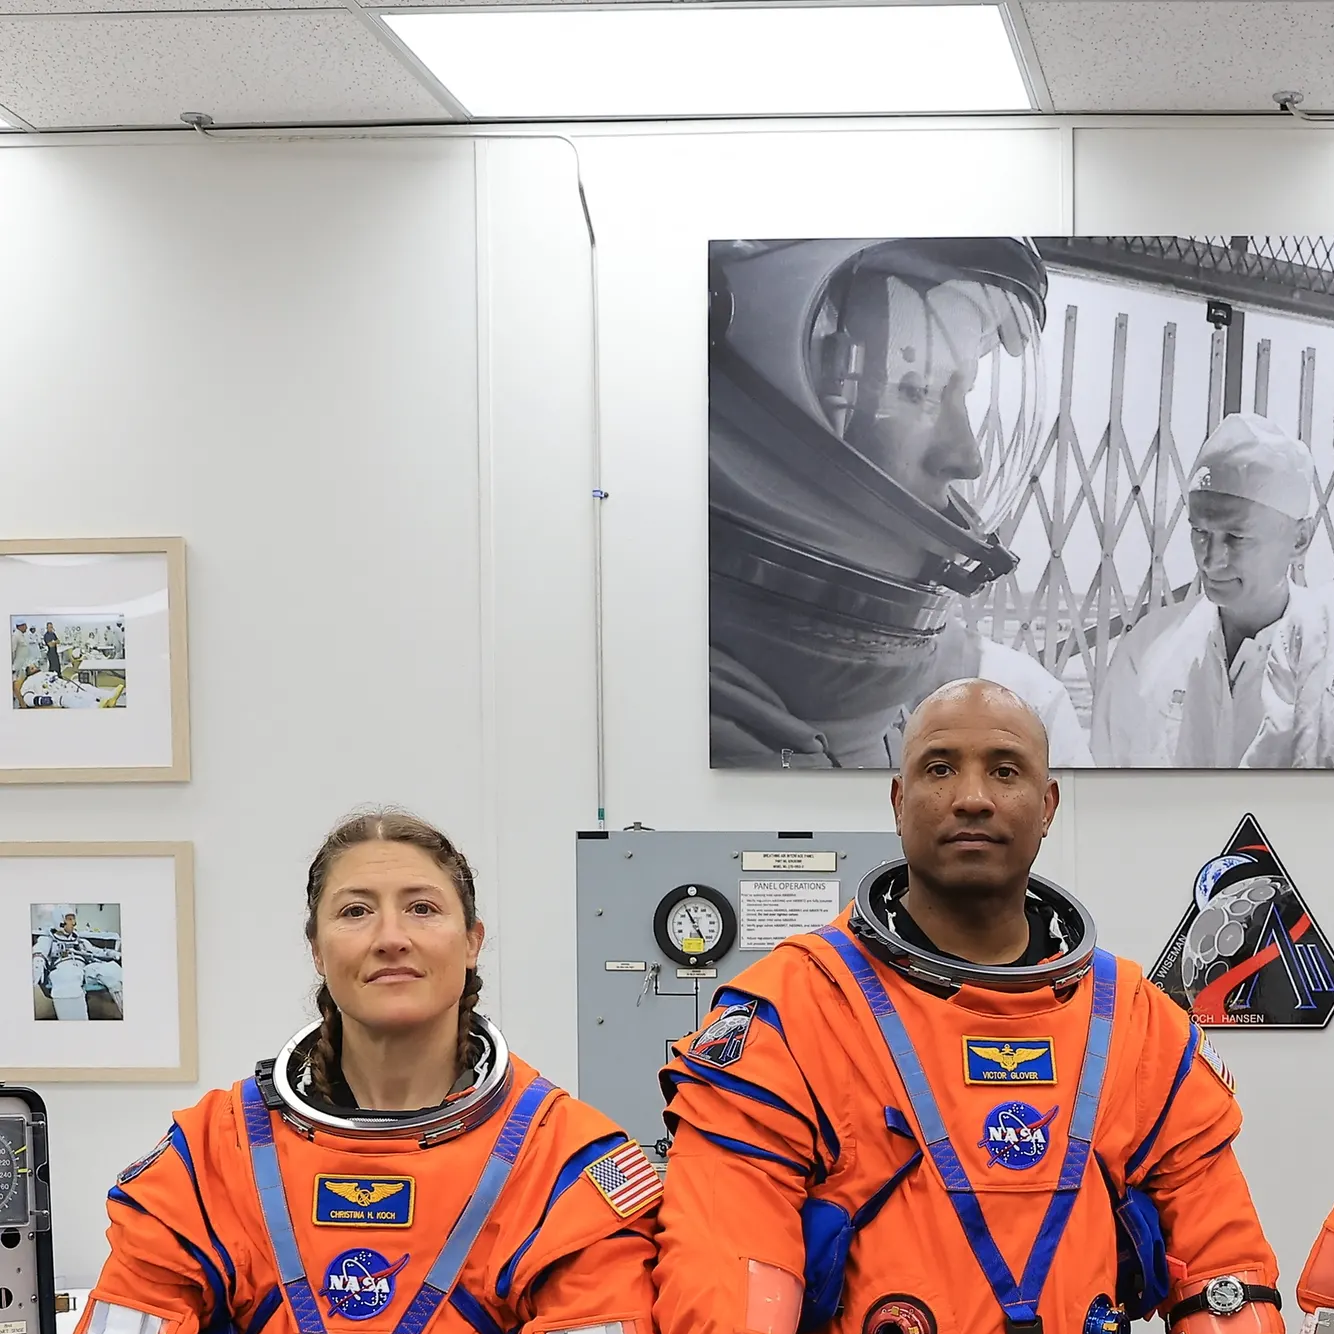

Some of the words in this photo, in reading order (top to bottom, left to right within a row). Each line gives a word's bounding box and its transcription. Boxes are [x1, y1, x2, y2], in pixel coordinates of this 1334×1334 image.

[754, 882, 777, 890] PANEL
[778, 882, 826, 890] OPERATIONS
[1156, 934, 1187, 979] WISEMAN
[1222, 1014, 1264, 1023] HANSEN
[983, 1071, 1007, 1079] VICTOR
[1010, 1072, 1038, 1080] GLOVER
[988, 1126, 1046, 1143] NASA
[330, 1210, 364, 1219] CHRISTINA
[376, 1212, 396, 1220] KOCH
[329, 1274, 390, 1293] NASA
